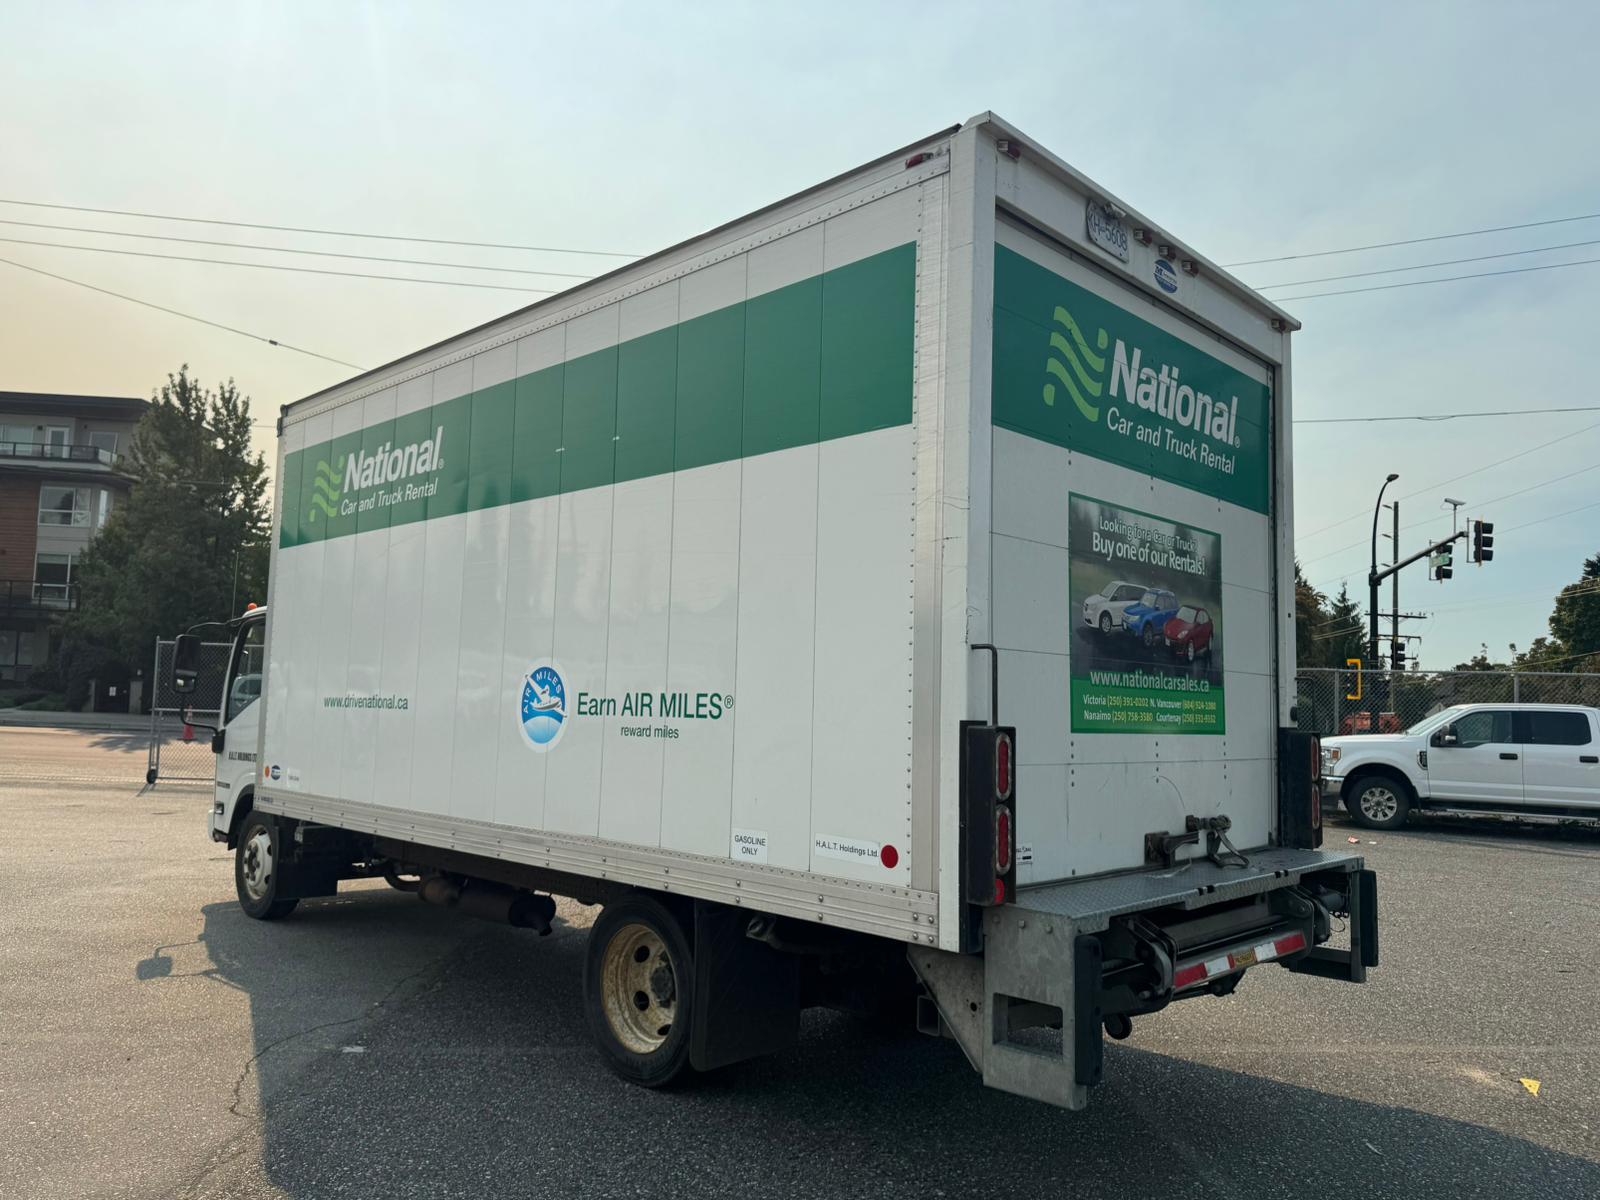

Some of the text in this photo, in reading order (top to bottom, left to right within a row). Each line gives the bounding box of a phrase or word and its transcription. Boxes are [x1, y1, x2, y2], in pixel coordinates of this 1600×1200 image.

[1107, 407, 1235, 475] Car and Truck Rental
[341, 478, 438, 516] Car and Truck Rental
[1100, 516, 1132, 541] Looking
[1132, 524, 1146, 540] for
[1153, 529, 1166, 545] Car
[1092, 532, 1205, 575] Buy one of our Rentals!
[536, 670, 562, 694] MILES
[1090, 670, 1209, 692] www.nationalcarsales.ca
[324, 694, 408, 710] www.drivenational.ca
[577, 692, 616, 716] Earn
[621, 692, 653, 717] AIR
[1083, 694, 1106, 705] Victoria
[1084, 710, 1111, 720] Nanaimo
[620, 725, 679, 739] reward miles
[734, 834, 766, 847] GASOLINE
[839, 843, 866, 856] Holdings
[742, 847, 758, 856] ONLY
